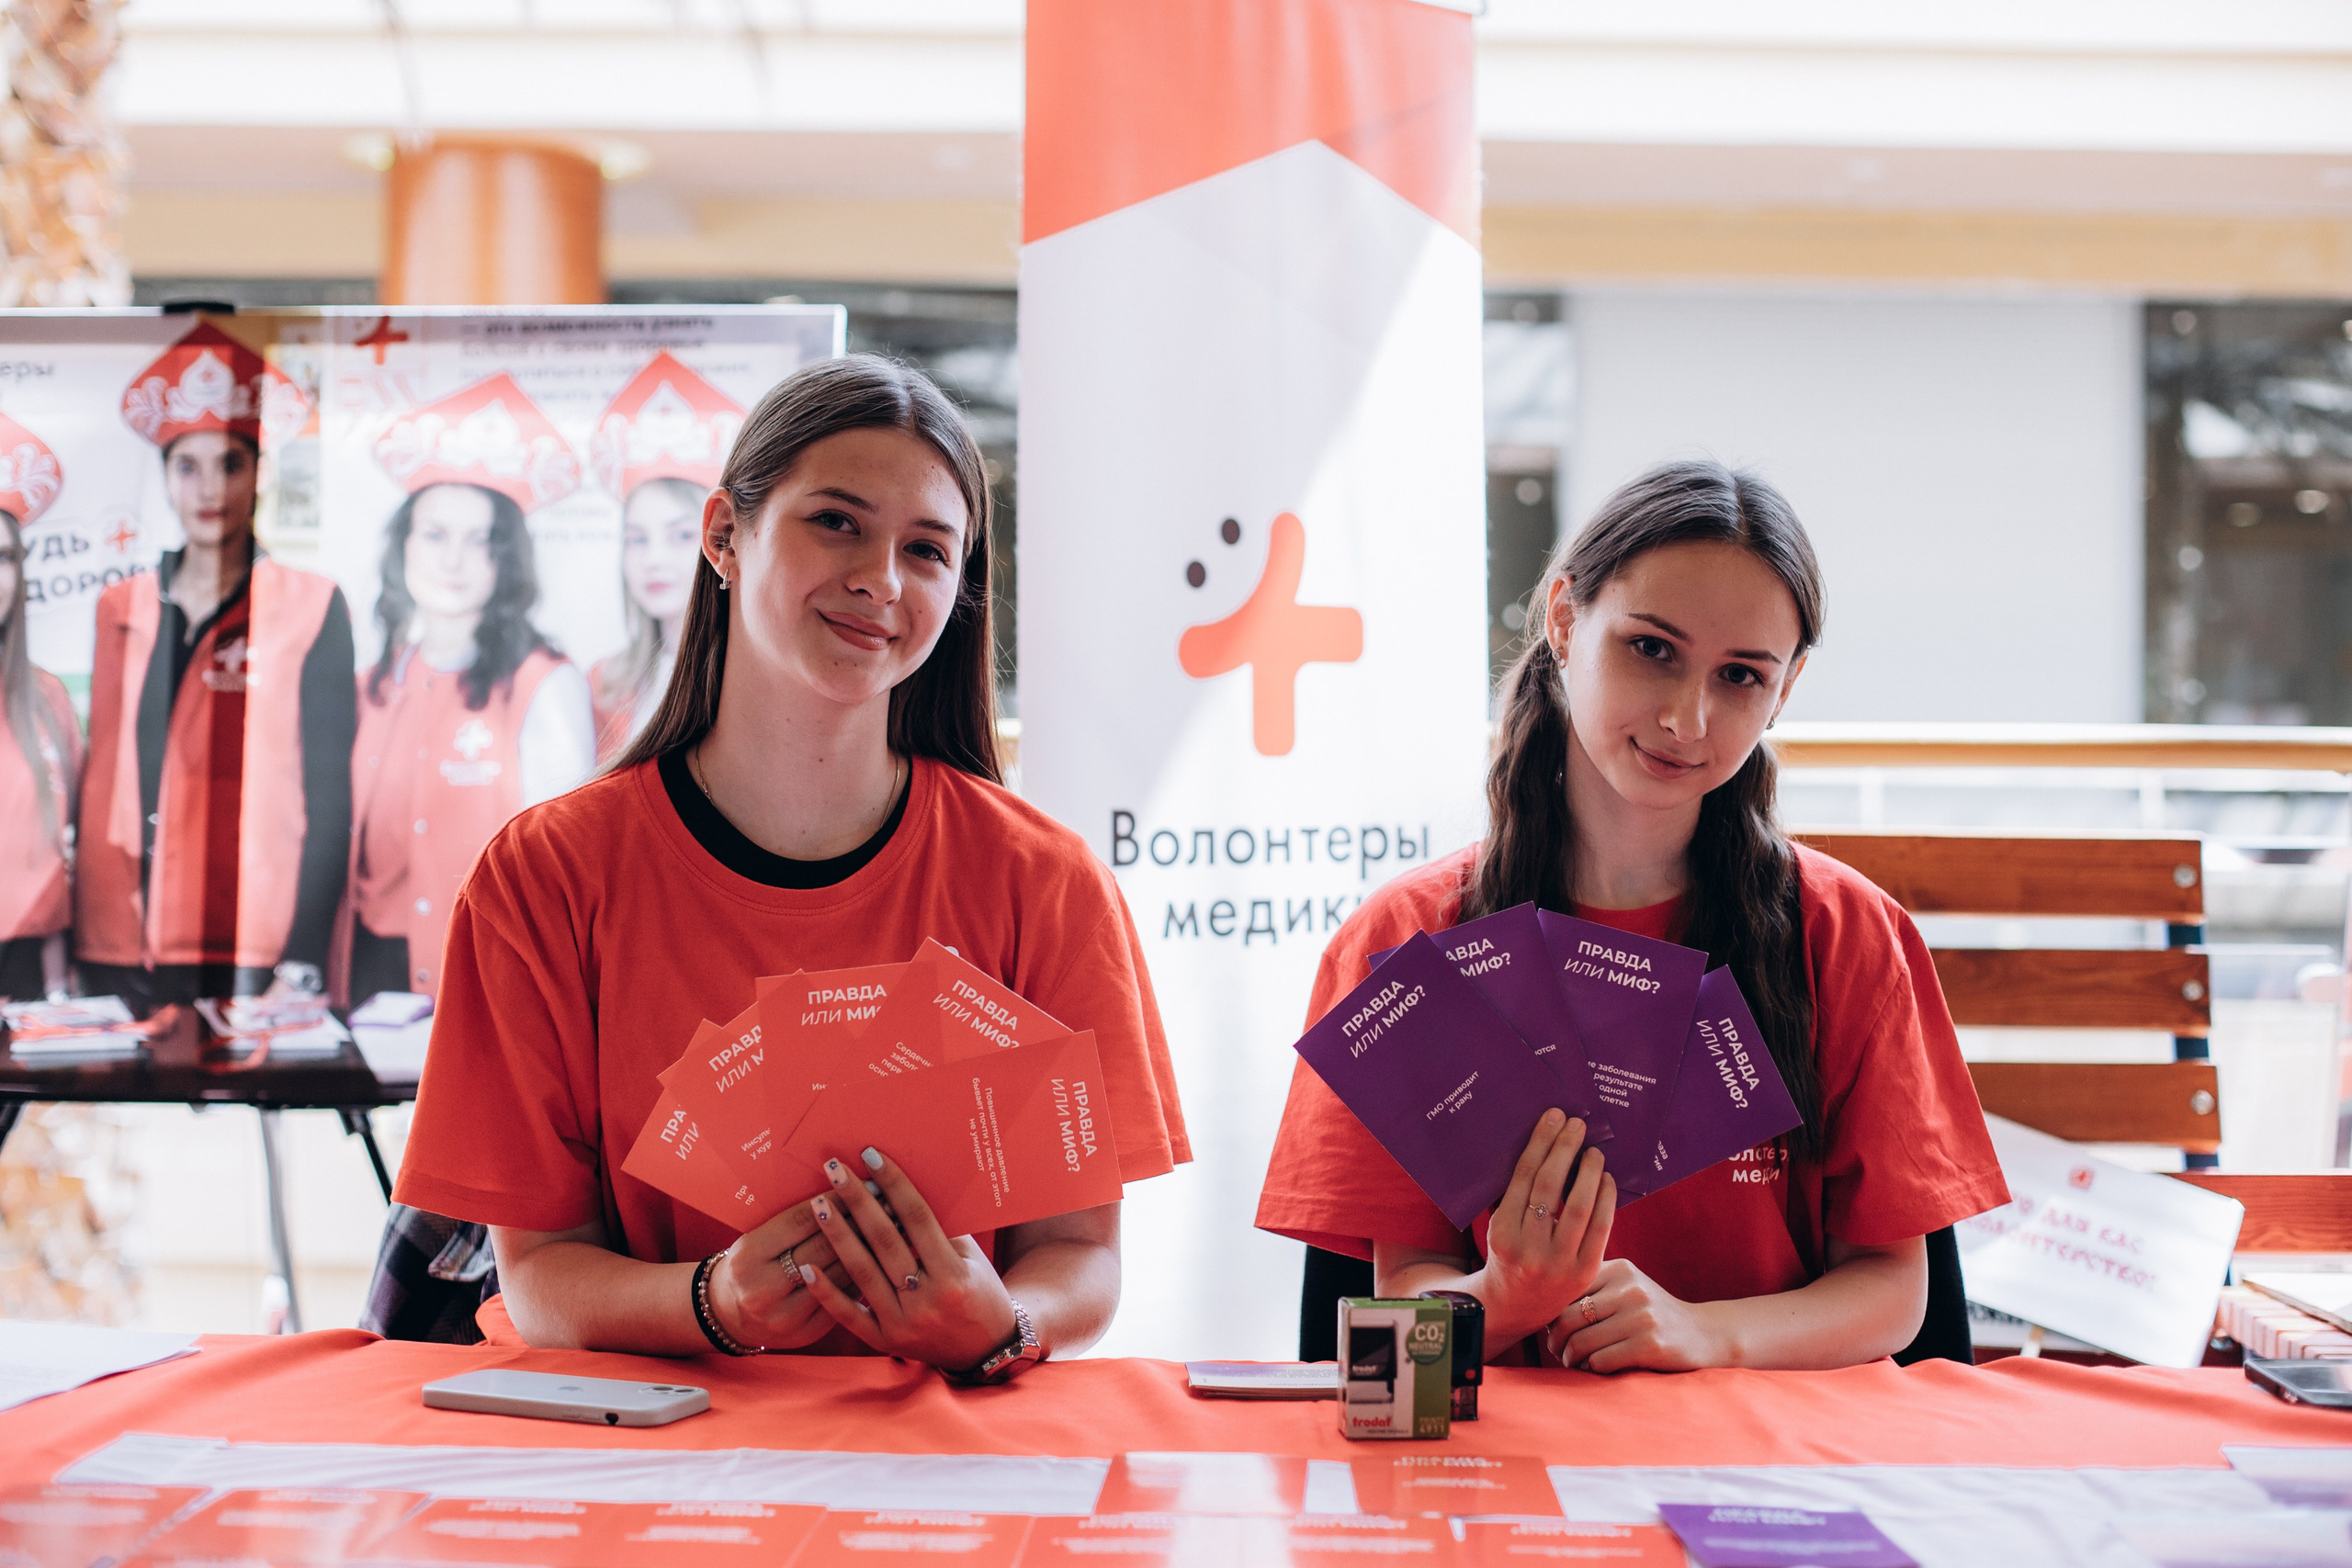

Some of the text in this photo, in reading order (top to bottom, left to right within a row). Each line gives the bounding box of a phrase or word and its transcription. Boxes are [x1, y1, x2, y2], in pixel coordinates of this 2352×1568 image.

[1112, 809, 1429, 880] Волонтеры
[1163, 895, 1363, 947] медик
[1460, 952, 1511, 978] МИФ?
[1577, 941, 1653, 973] ПРАВДА
[1564, 958, 1661, 995] ИЛИ МИФ?
[808, 984, 888, 1005] ПРАВДА
[933, 993, 972, 1022] ИЛИ
[952, 979, 1019, 1031] ПРАВДА
[1341, 980, 1406, 1038] ПРАВДА
[801, 1009, 842, 1026] ИЛИ
[1350, 985, 1426, 1059] ИЛИ МИФ?
[896, 1042, 933, 1067] Сердечн
[1696, 1019, 1749, 1109] ИЛИ МИФ?
[1718, 1017, 1760, 1091] ПРАВДА
[716, 1060, 752, 1093] ИЛИ
[1593, 1073, 1644, 1091] результате
[1598, 1064, 1657, 1085] заболевания
[972, 1077, 984, 1111] бывает
[1426, 1070, 1480, 1121] ГМО приводит
[1449, 1090, 1473, 1114] к раку
[1599, 1084, 1628, 1098] одной
[661, 1104, 688, 1143] ПРА
[978, 1111, 989, 1139] почти
[1051, 1078, 1080, 1172] ИЛИ МИФ?
[1072, 1080, 1098, 1157] ПРАВДА
[741, 1127, 771, 1152] Инсуль
[756, 1140, 772, 1155] кур
[969, 1118, 985, 1171] не умирают
[984, 1087, 1010, 1193] Повышенное давление
[985, 1147, 994, 1170] всех,
[989, 1171, 997, 1181] от
[992, 1183, 1001, 1207] этого
[1352, 1416, 1392, 1427] trodat
